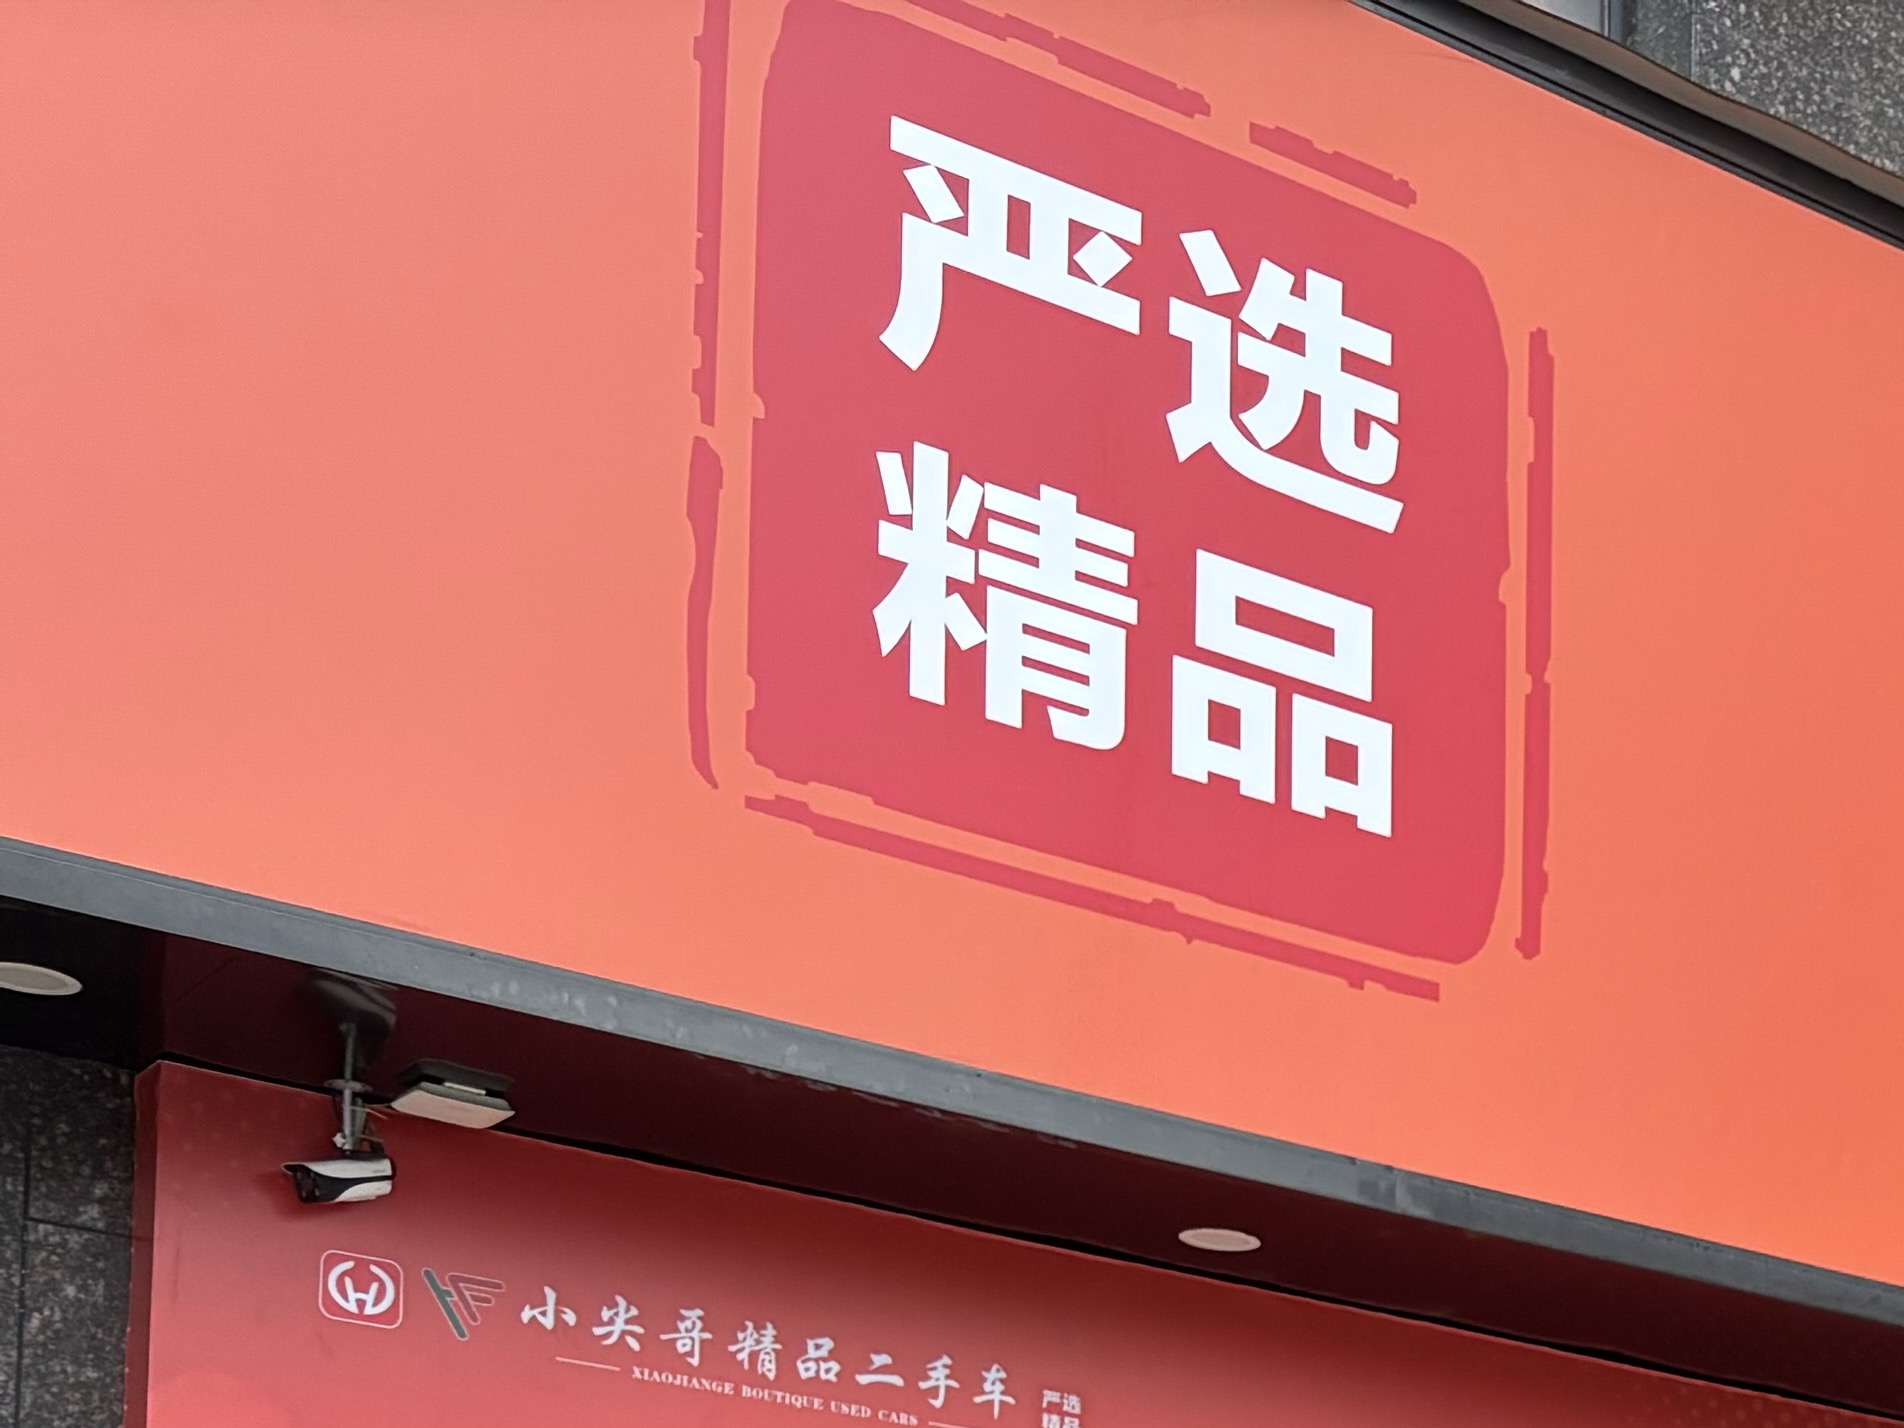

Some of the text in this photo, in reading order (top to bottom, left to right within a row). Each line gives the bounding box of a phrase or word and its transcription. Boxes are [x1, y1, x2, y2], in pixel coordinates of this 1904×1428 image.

[879, 114, 1404, 534] 严选
[872, 440, 1393, 838] 精品
[520, 1286, 1016, 1419] 小尖哥精品二手车
[631, 1365, 919, 1428] XIAOJIANGE BOUTIQUE USED CARS
[1042, 1389, 1081, 1415] 严选
